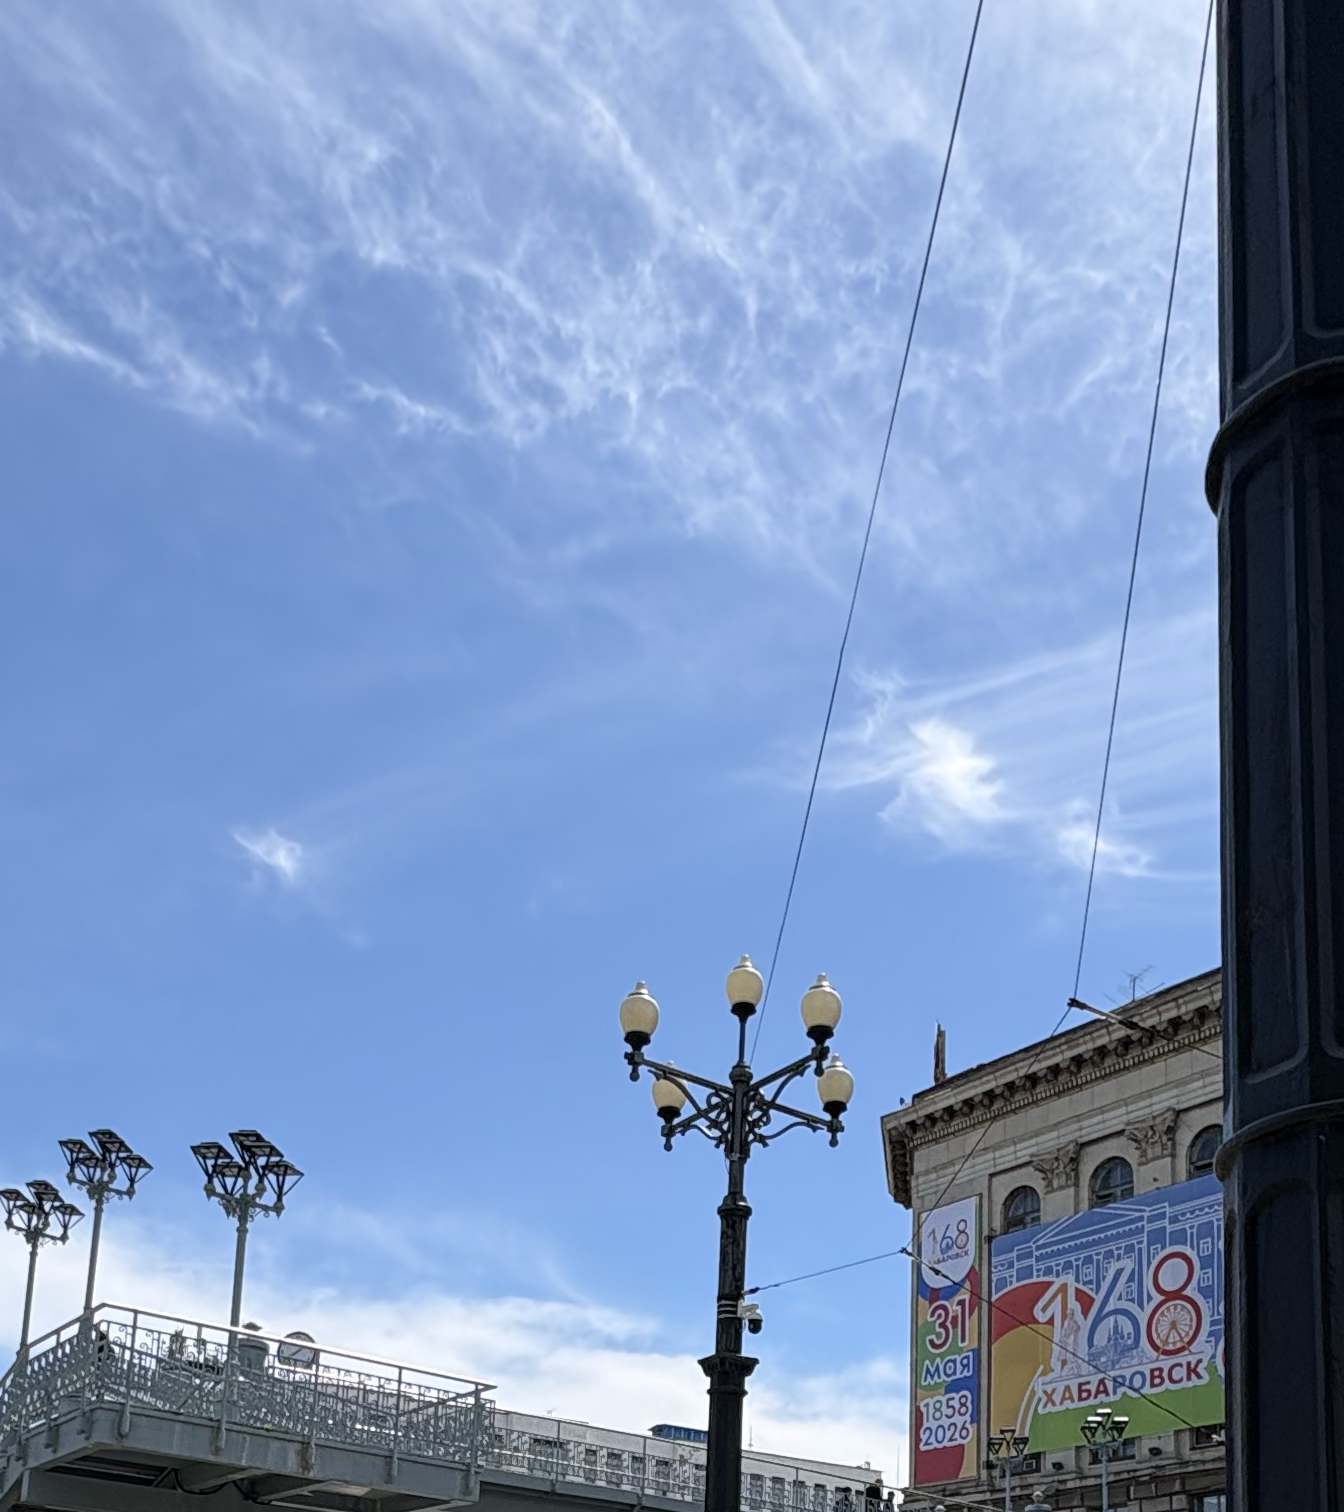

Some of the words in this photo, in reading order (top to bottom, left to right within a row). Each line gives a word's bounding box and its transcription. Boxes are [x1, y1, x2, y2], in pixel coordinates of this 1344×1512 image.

[927, 1218, 970, 1256] 168
[928, 1298, 967, 1351] 31
[1040, 1251, 1203, 1372] 168
[1042, 1358, 1204, 1409] ХАБАРОВСК
[923, 1394, 969, 1423] 1858
[922, 1420, 970, 1447] 2026
